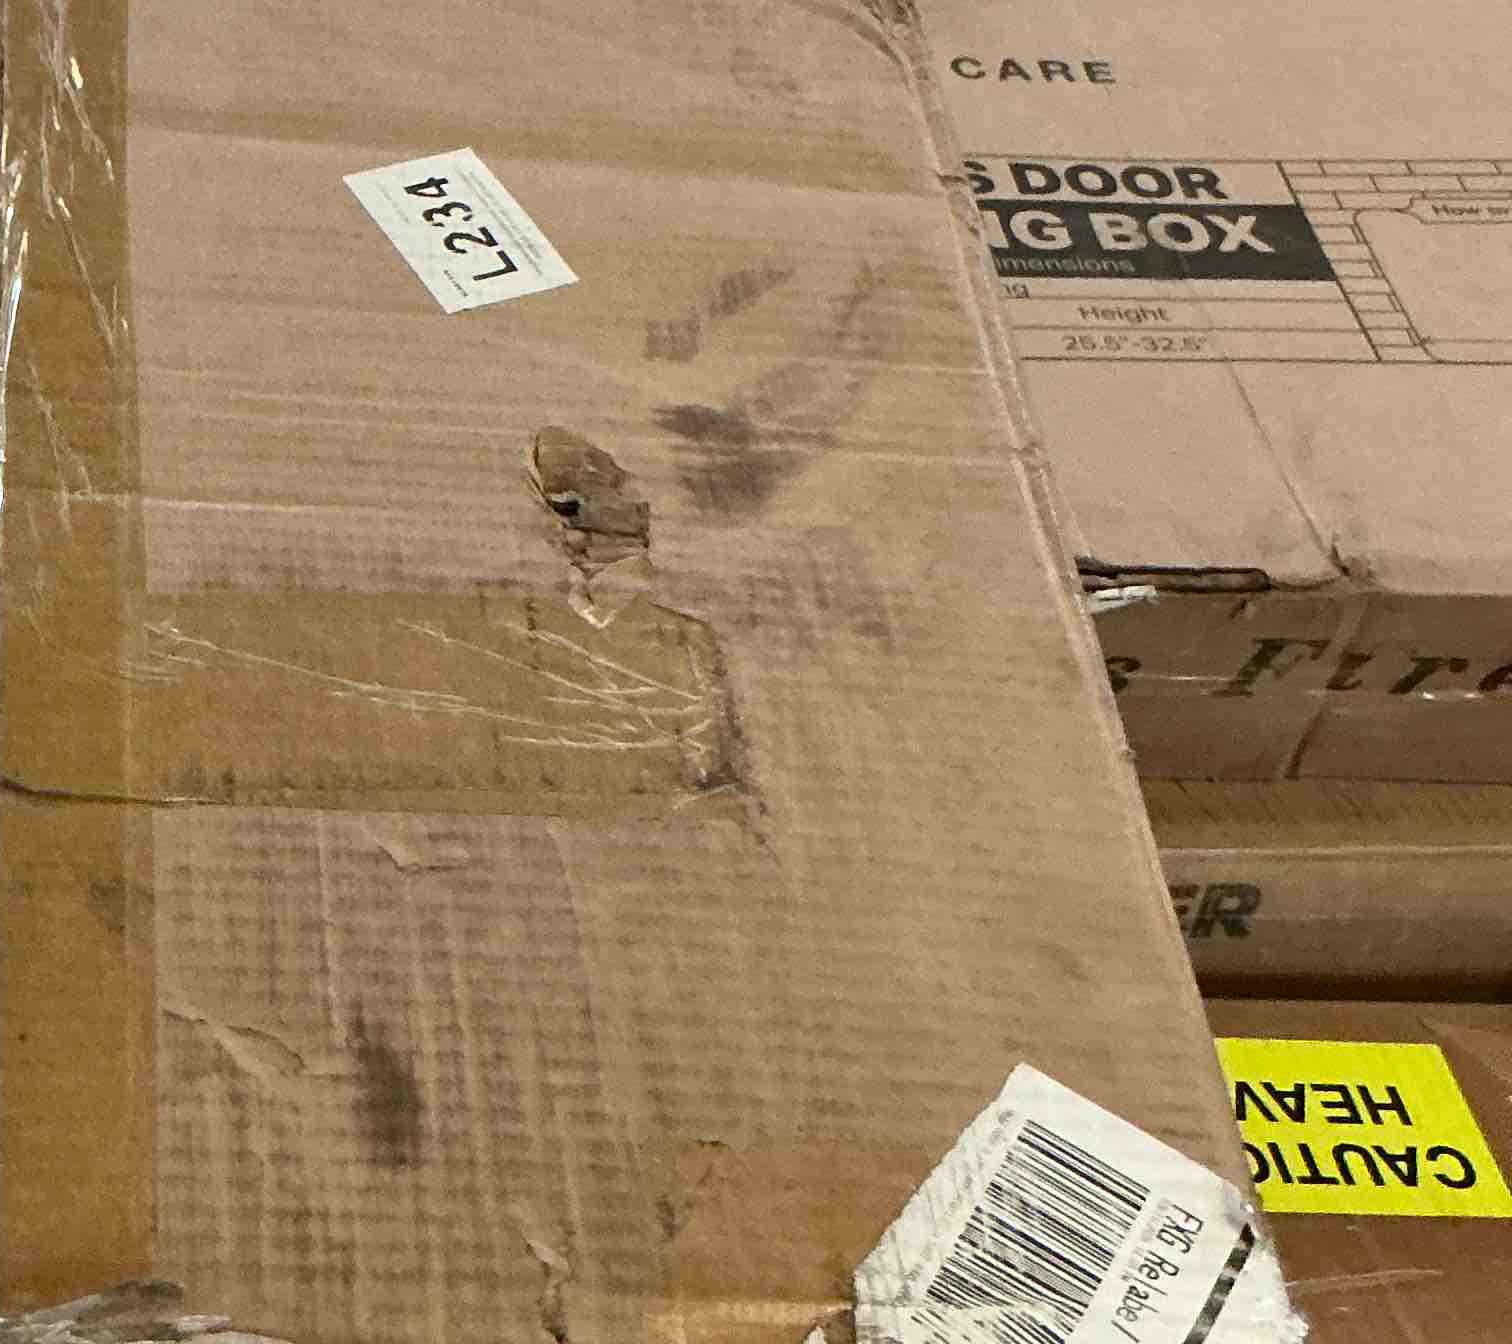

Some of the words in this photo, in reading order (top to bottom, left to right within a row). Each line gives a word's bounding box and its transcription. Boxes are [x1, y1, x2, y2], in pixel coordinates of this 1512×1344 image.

[949, 56, 1117, 85] CARE
[1008, 161, 1229, 200] DOOR
[403, 176, 519, 281] L234
[1088, 211, 1277, 253] BOX
[995, 254, 1136, 274] imensions
[1077, 305, 1169, 323] Height
[1235, 1080, 1414, 1126] HEAV
[1242, 1142, 1477, 1189] CAUTIO
[1159, 1204, 1205, 1254] FXG
[1111, 1254, 1180, 1344] Relabel
